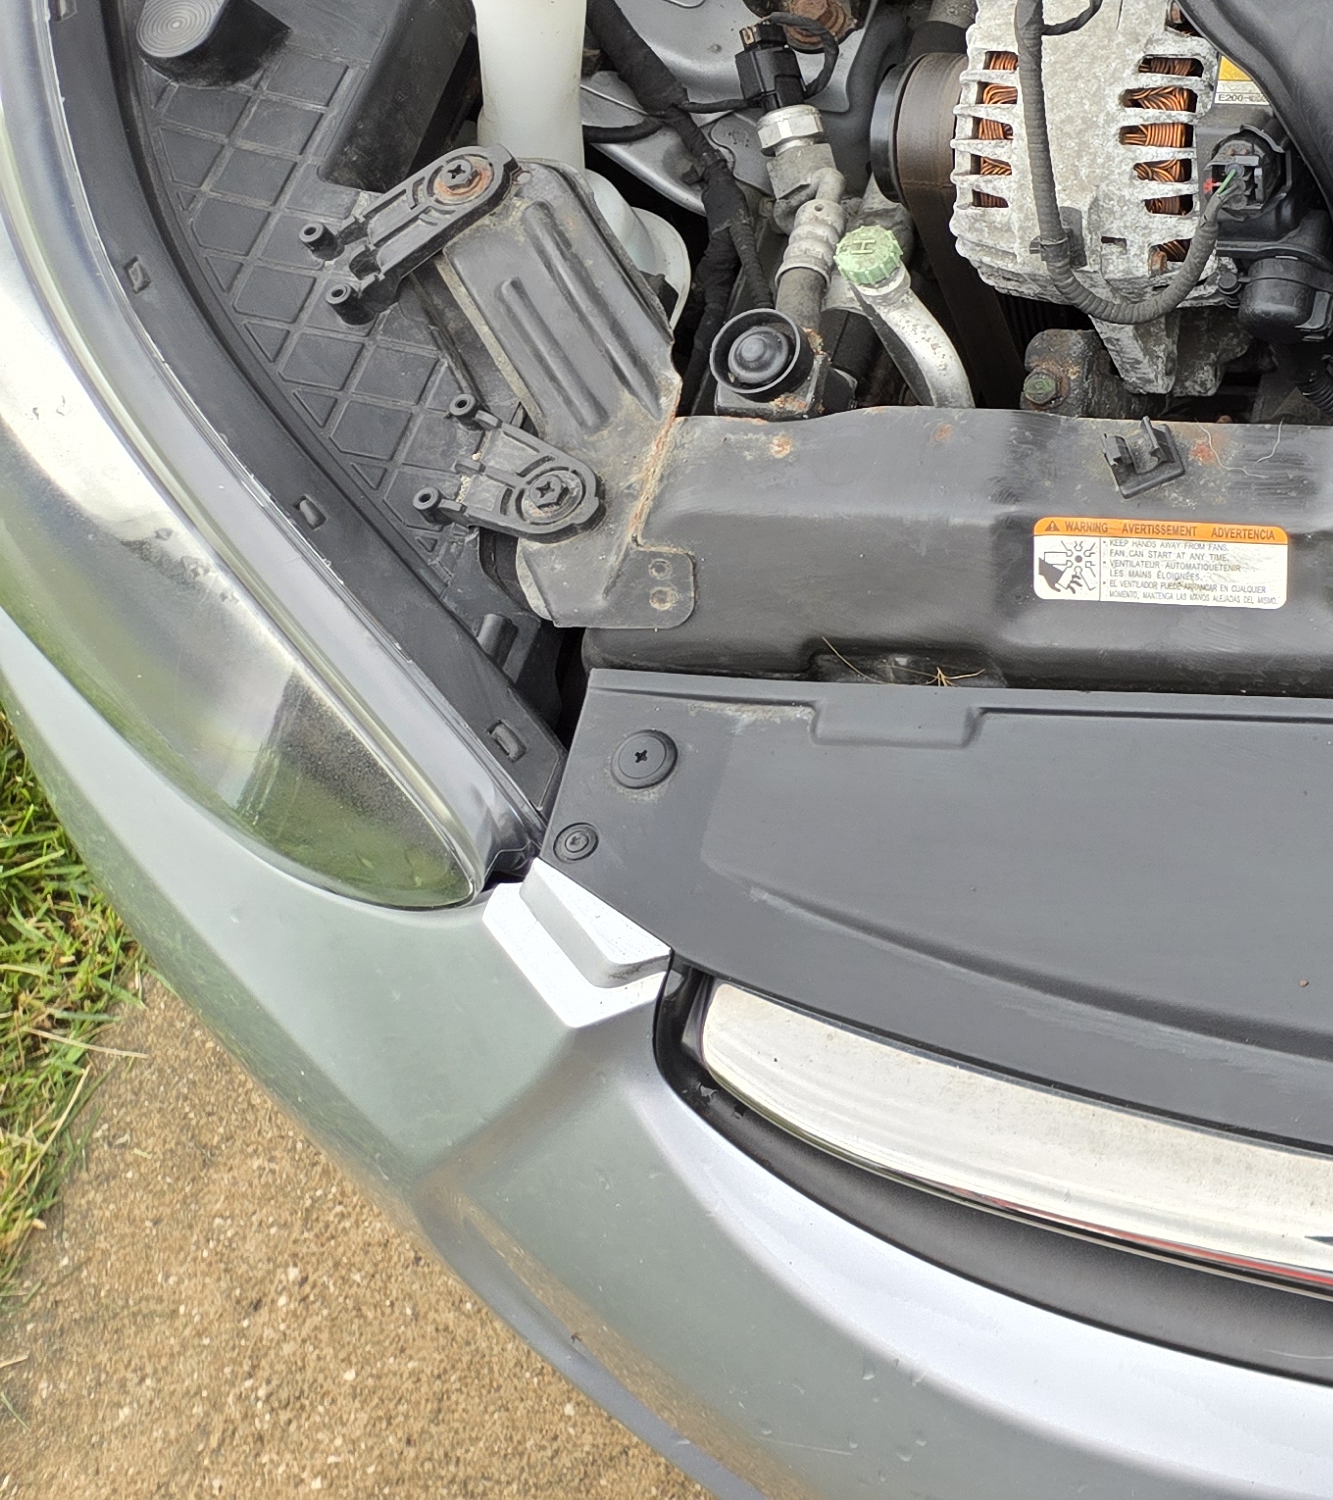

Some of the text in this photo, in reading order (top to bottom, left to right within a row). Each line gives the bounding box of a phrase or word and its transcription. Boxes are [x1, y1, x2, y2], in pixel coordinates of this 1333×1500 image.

[1064, 521, 1275, 540] WARNING AVERTISSEMENT ADVERTENCIA
[1109, 539, 1129, 547] KEEP
[1132, 541, 1157, 549] HANDS
[1110, 549, 1125, 557] FAN
[1128, 550, 1144, 558] CAN
[1148, 551, 1172, 559] START
[1189, 552, 1205, 560] ANY
[1109, 560, 1161, 569] VENTILATEUR
[1128, 570, 1152, 579] MAINS
[1120, 581, 1158, 590] VENTILADOR
[1220, 584, 1229, 592] EN
[1231, 585, 1266, 594] CUALQUIER
